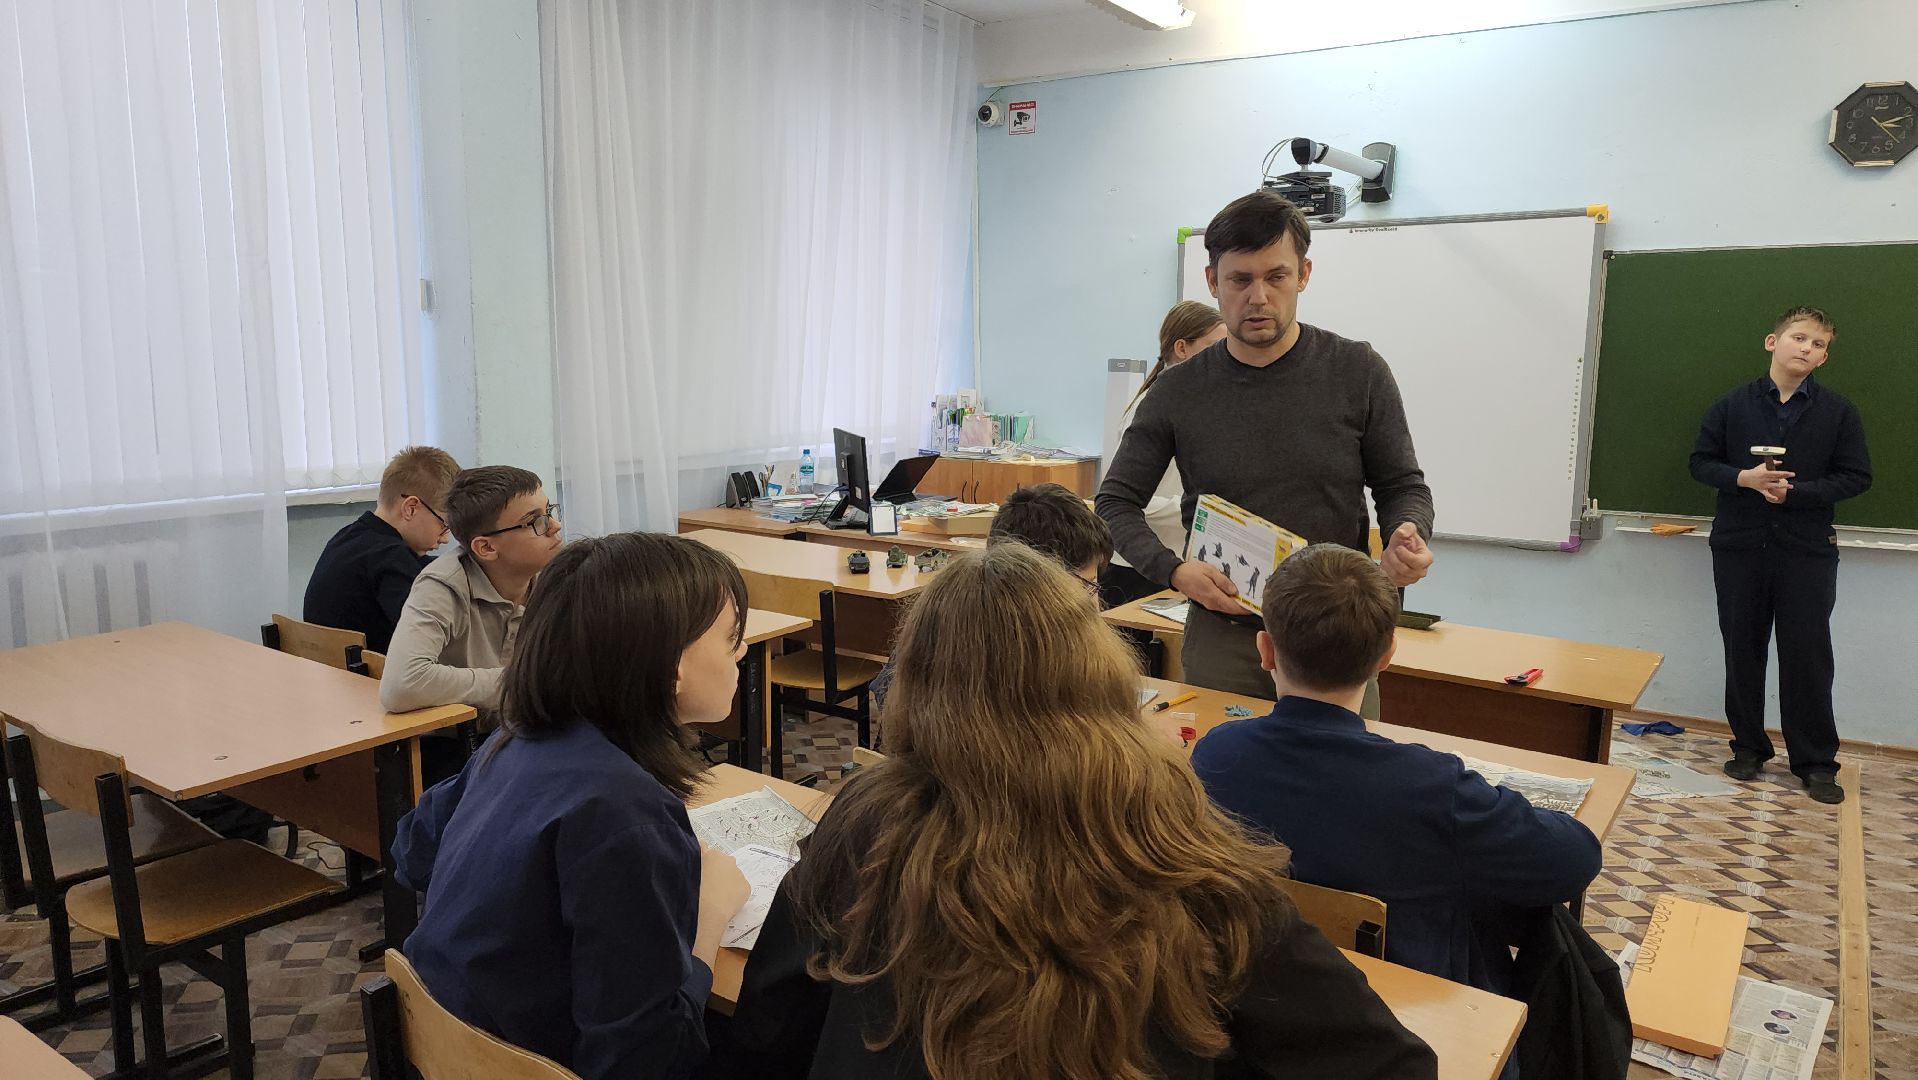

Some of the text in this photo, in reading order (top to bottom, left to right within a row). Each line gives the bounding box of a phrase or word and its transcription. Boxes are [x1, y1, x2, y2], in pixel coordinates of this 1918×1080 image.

[1878, 95, 1888, 105] 12
[1848, 133, 1857, 143] 8
[1859, 141, 1868, 152] 7
[1871, 145, 1881, 154] 6
